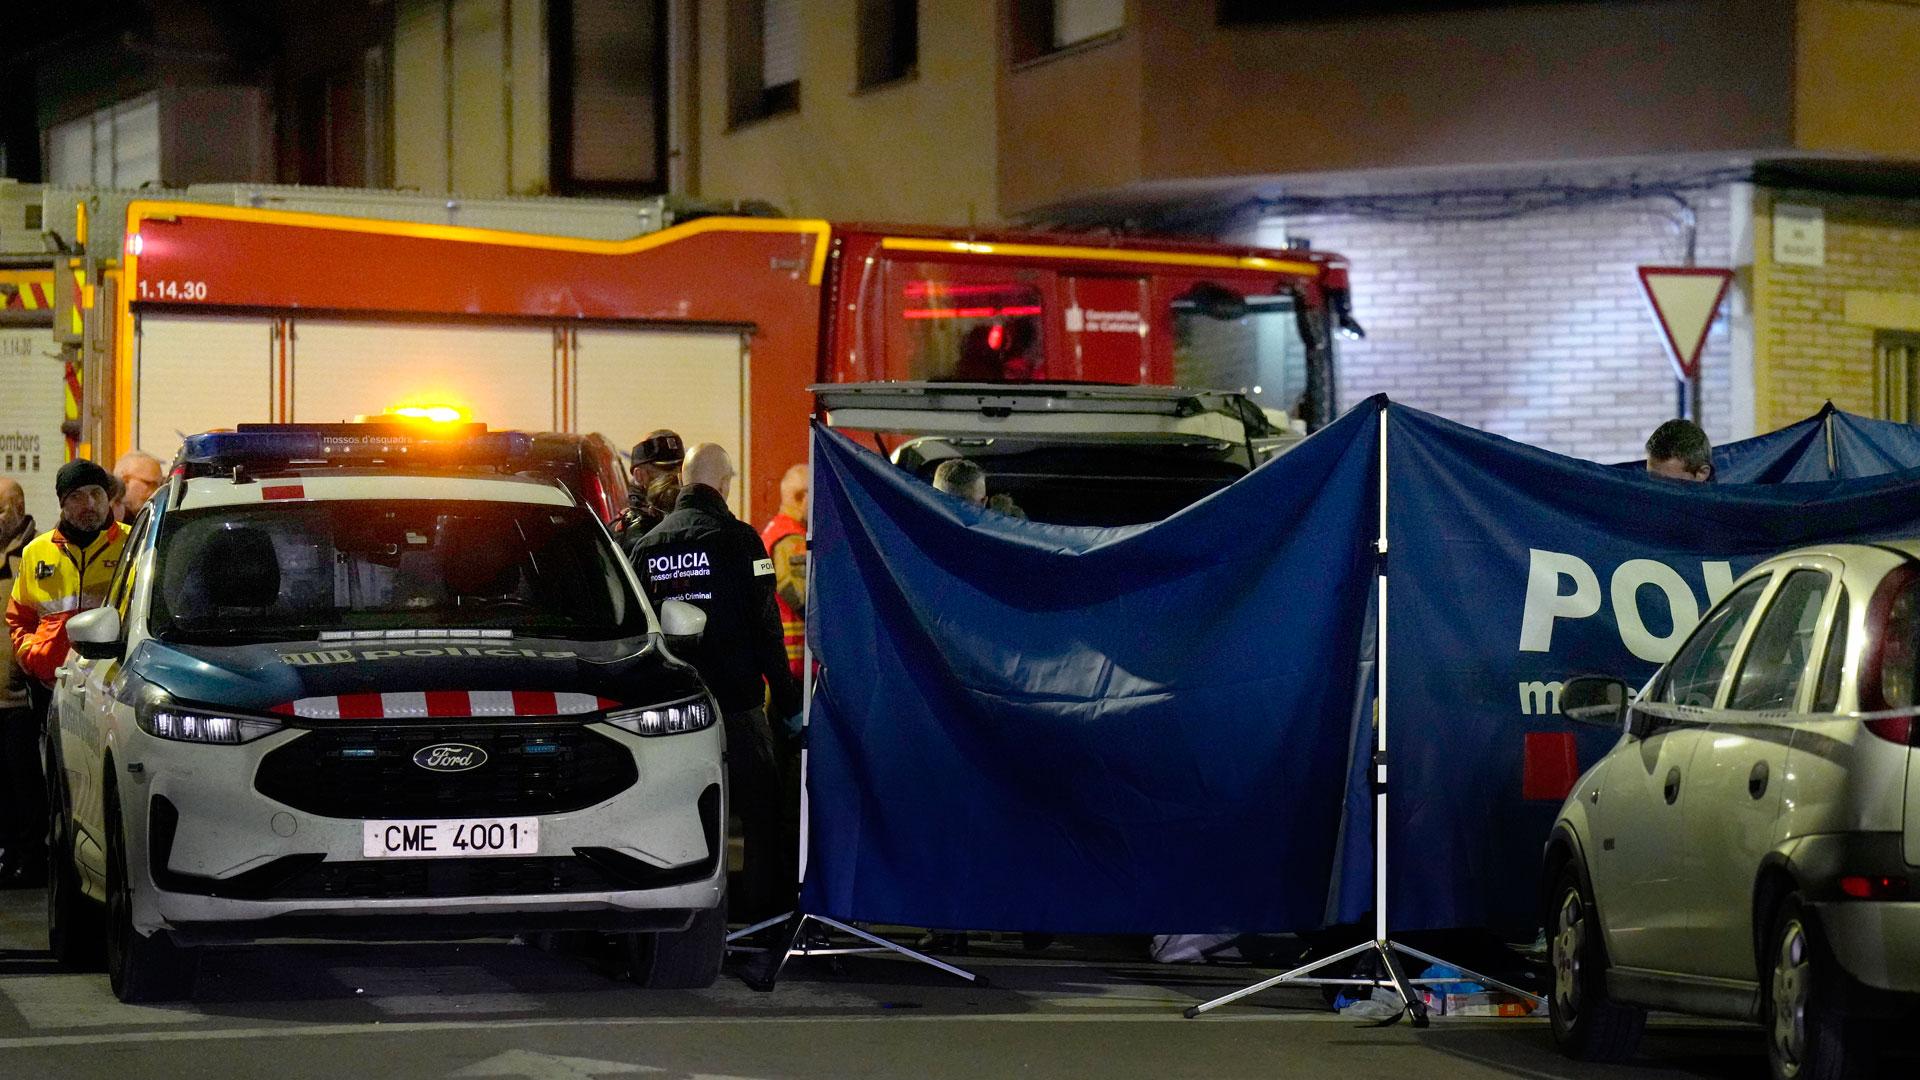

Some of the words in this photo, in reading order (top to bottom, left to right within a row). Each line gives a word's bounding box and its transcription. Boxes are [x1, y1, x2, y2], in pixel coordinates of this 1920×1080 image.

[139, 280, 207, 301] 1.14.30
[323, 436, 359, 444] mossos
[648, 552, 710, 573] POLICIA
[673, 568, 711, 579] d'esquadra
[685, 592, 712, 601] Criminal
[361, 647, 579, 661] policia
[427, 747, 474, 766] Ford
[385, 824, 437, 851] CME
[452, 823, 519, 850] 4001
